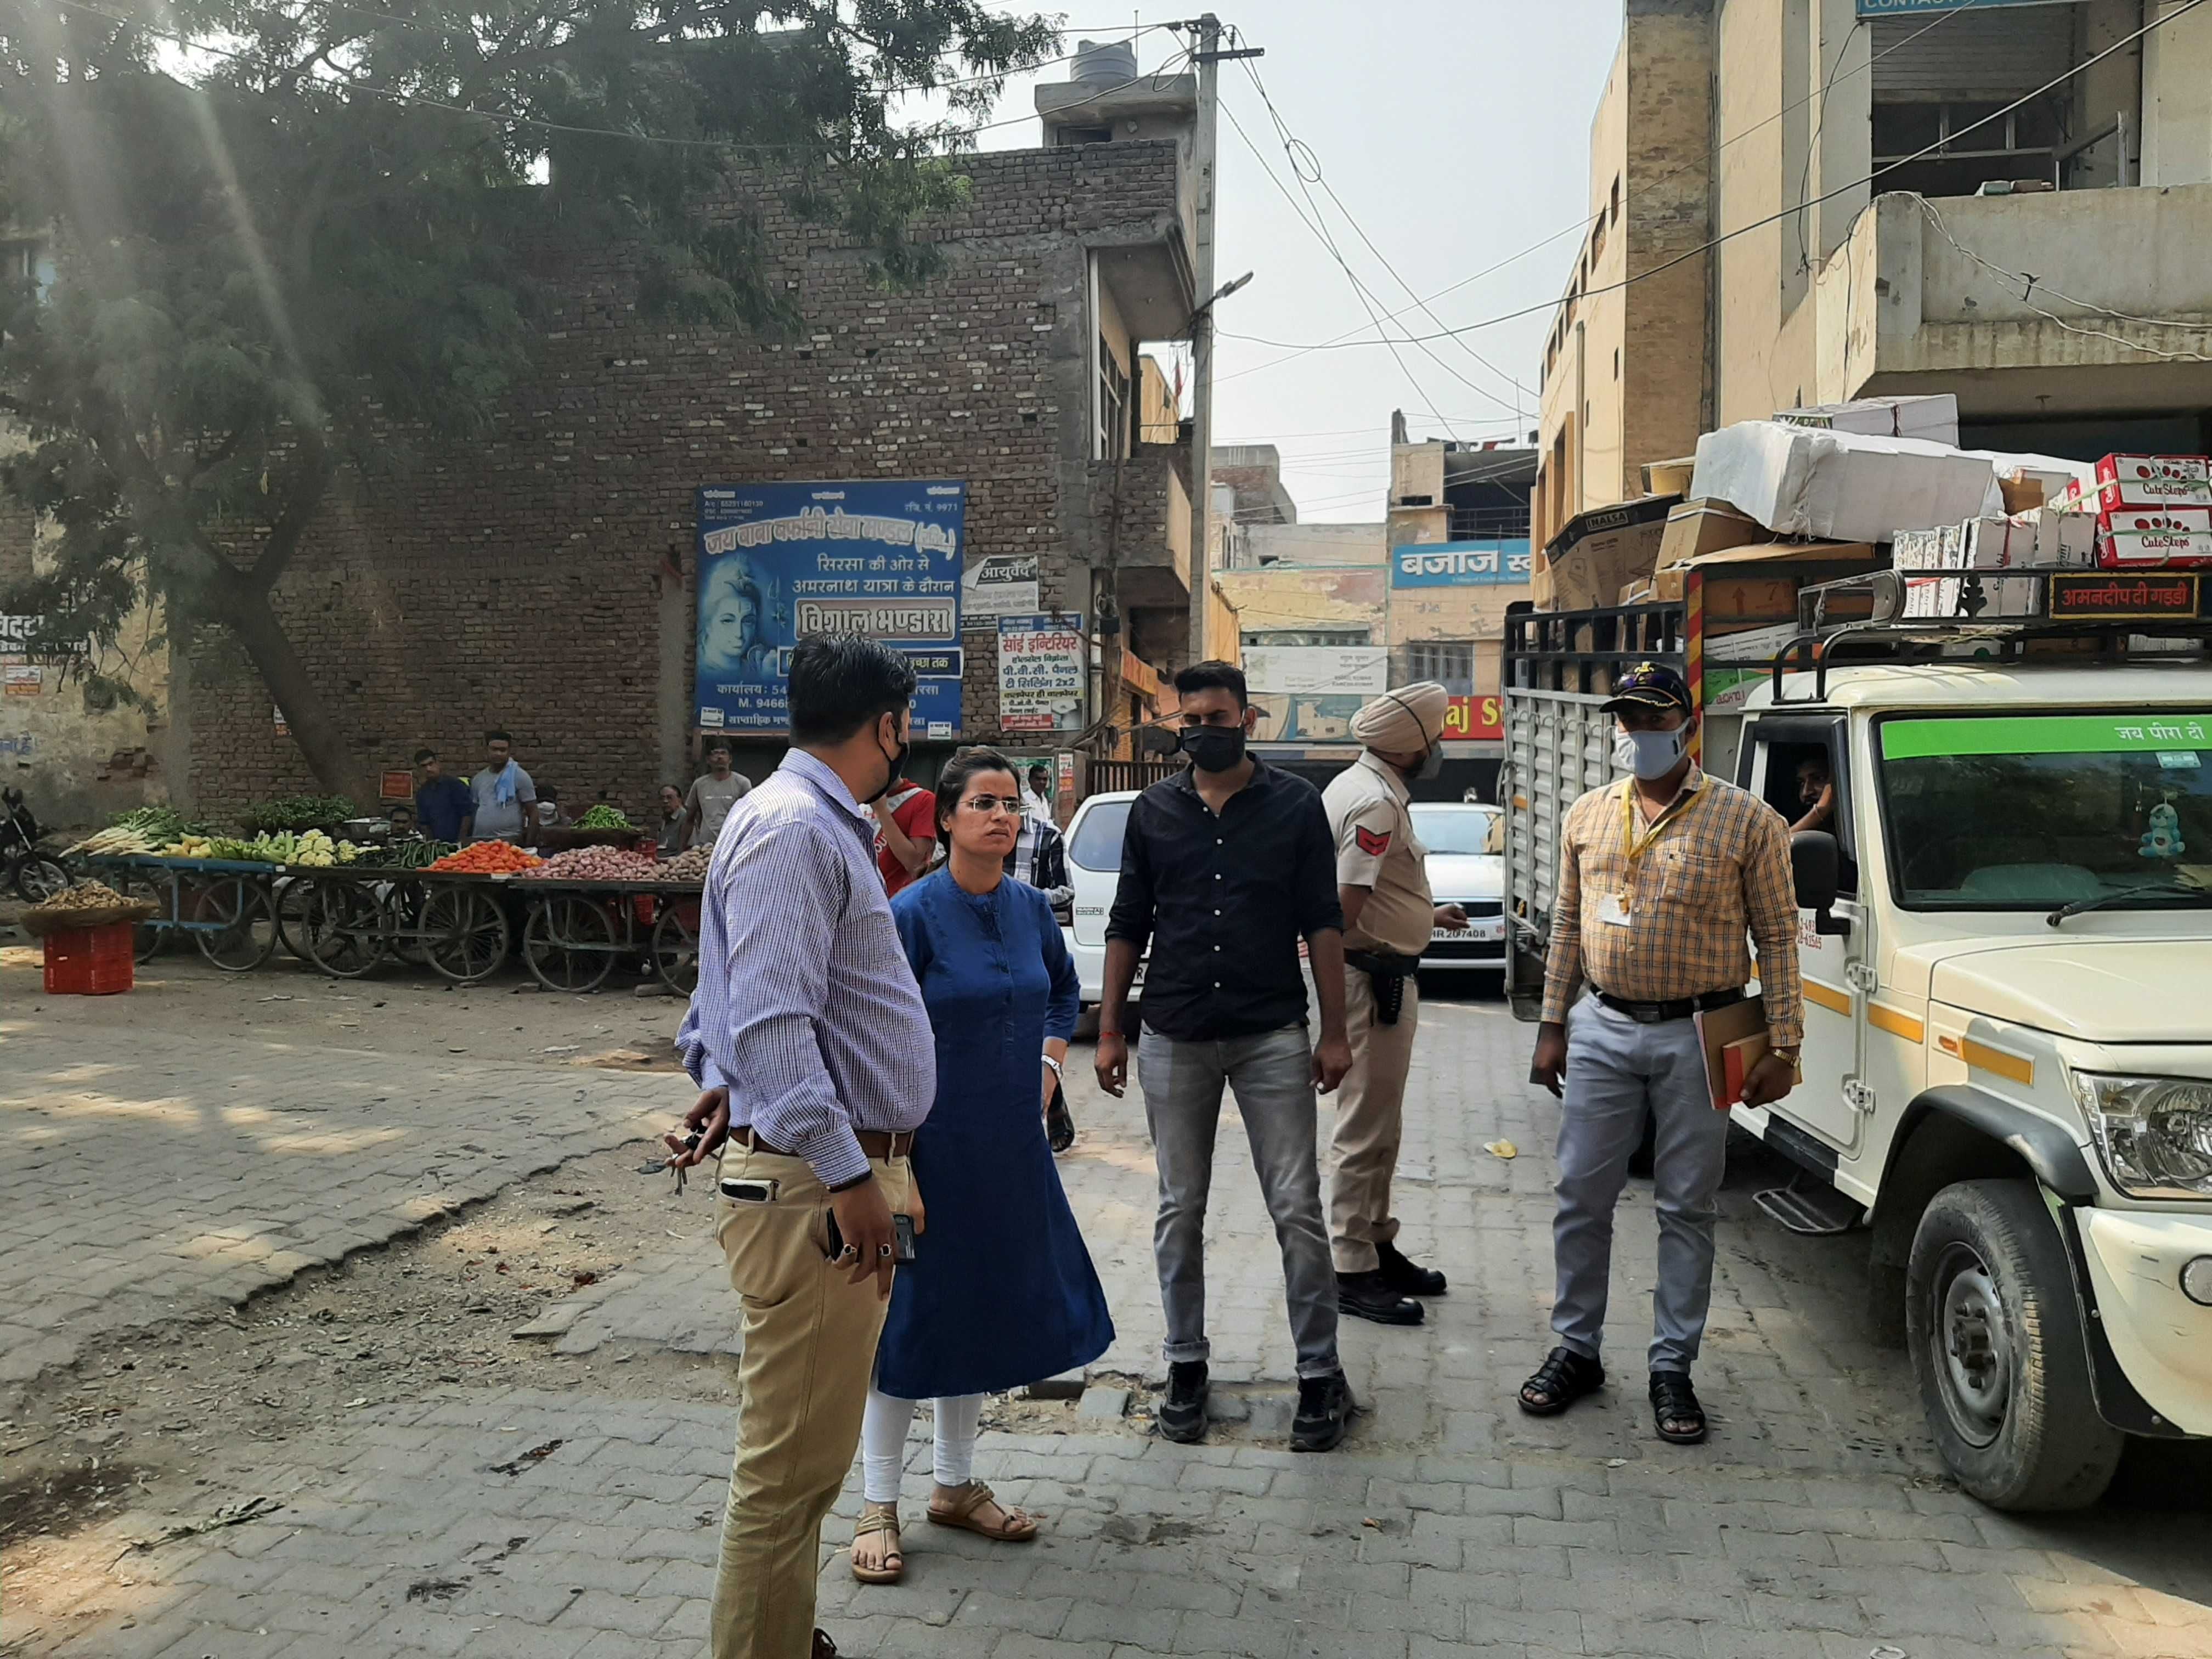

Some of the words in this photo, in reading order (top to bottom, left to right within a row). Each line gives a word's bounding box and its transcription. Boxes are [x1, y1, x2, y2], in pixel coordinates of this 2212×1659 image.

[936, 503, 958, 512] 9971
[1588, 511, 1627, 527] INALSA
[817, 553, 865, 571] सिरसा
[868, 555, 886, 571] की
[889, 555, 913, 571] ओर
[917, 554, 930, 571] से
[1401, 550, 1499, 575] बजाज
[792, 579, 859, 593] अमरनाथ
[862, 578, 899, 593] यात्रा
[902, 576, 916, 592] के
[918, 577, 956, 593] दौरान
[2062, 581, 2131, 606] अमनदीप
[2131, 580, 2149, 606] दी
[799, 603, 872, 634] विशाल
[877, 609, 951, 634] भण्डारा
[932, 657, 950, 668] तक
[1481, 698, 1503, 725] S
[2114, 726, 2145, 740] जय
[2147, 721, 2183, 740] पीरा
[2185, 721, 2205, 741] दी
